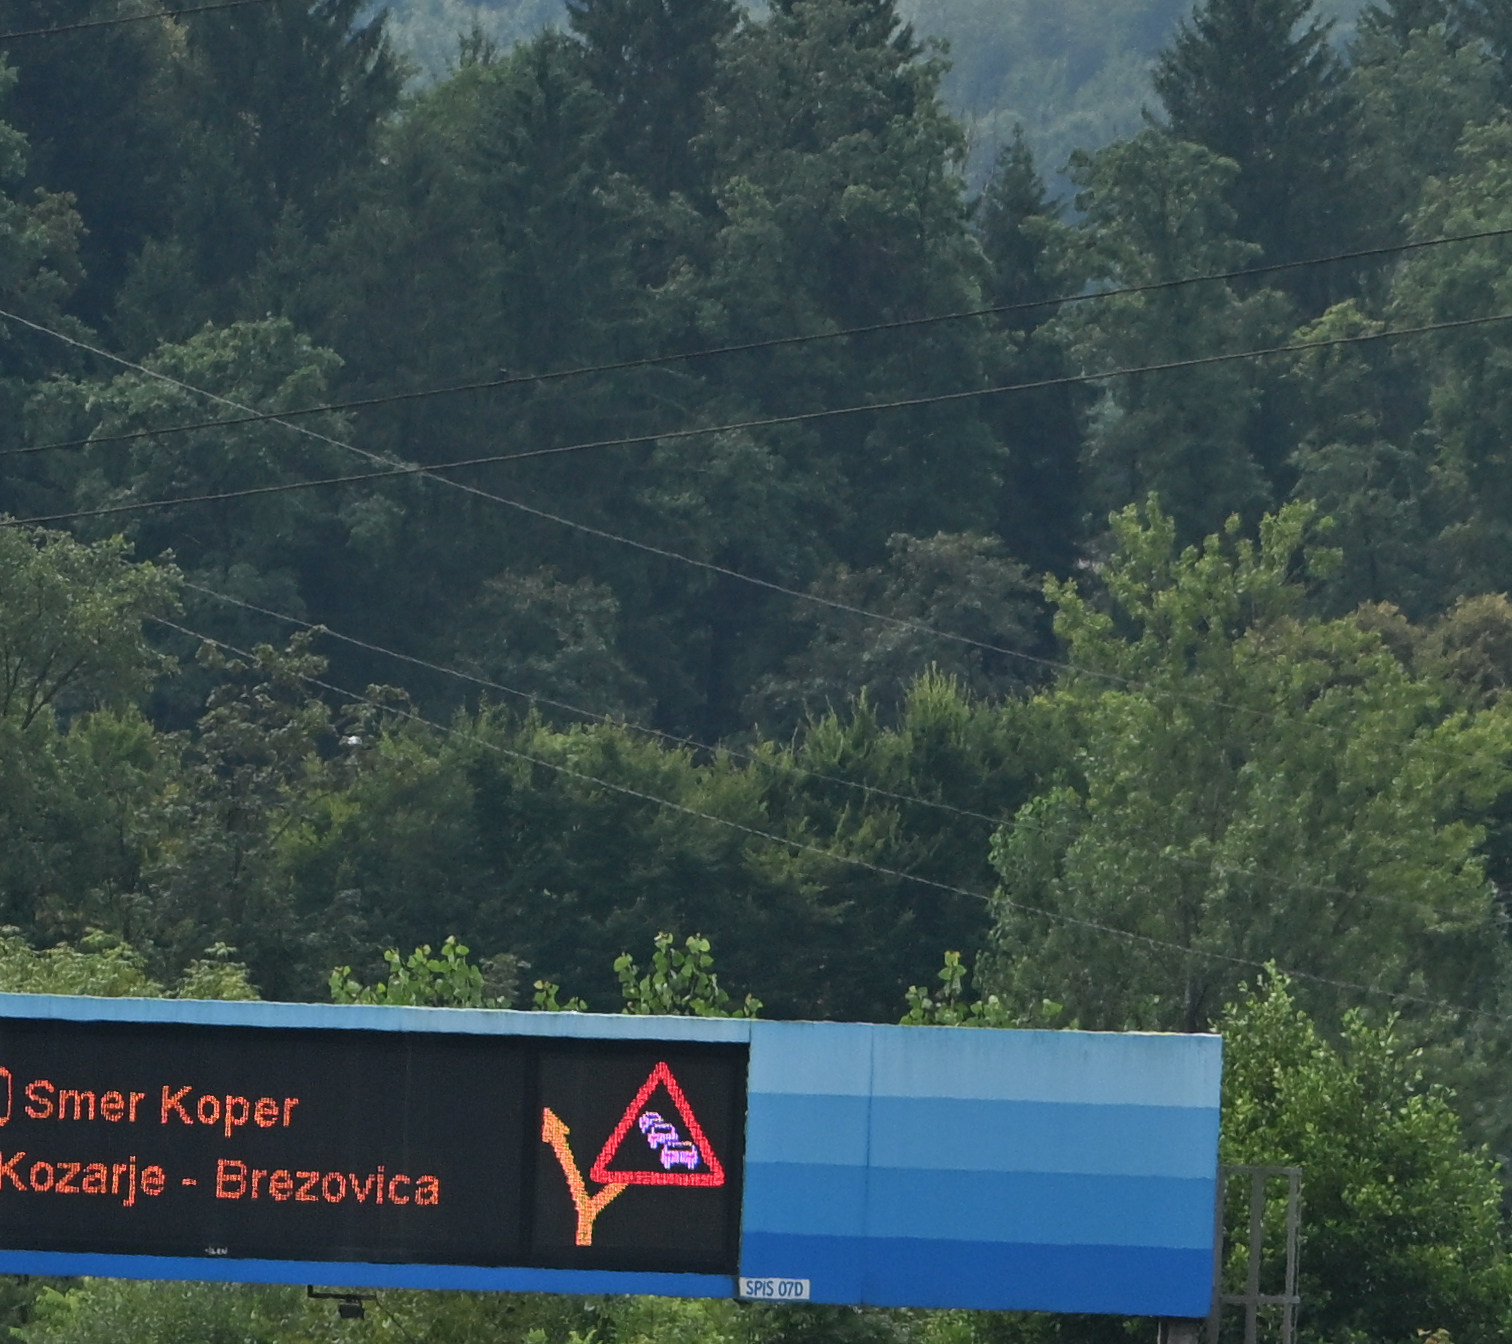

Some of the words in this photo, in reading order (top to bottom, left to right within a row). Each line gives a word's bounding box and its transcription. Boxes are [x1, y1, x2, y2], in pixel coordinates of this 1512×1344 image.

[25, 1081, 145, 1122] Smer
[161, 1087, 300, 1136] Koper
[216, 1160, 441, 1207] Brezovica
